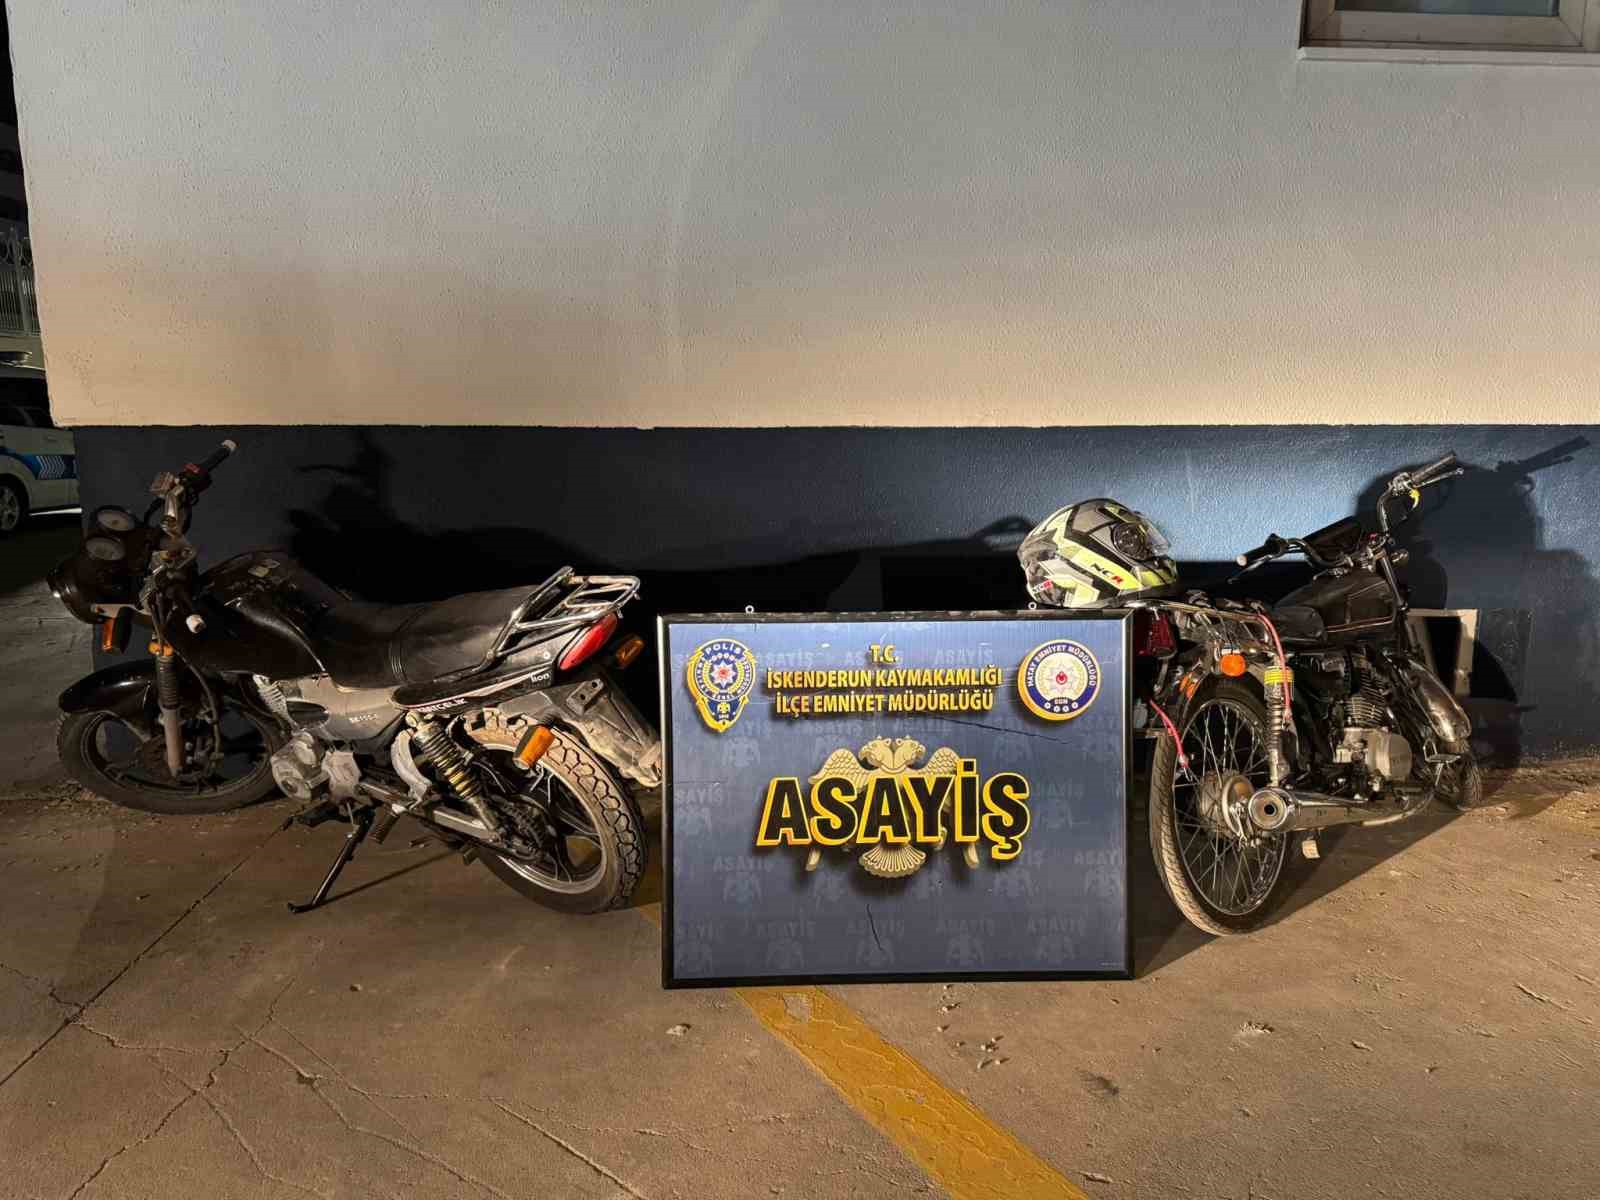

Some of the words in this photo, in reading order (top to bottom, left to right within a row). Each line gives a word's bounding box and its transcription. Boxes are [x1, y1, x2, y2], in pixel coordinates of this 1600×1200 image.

[1091, 562, 1124, 584] NCR
[704, 642, 742, 655] POLİS
[869, 645, 899, 663] T.C.
[767, 668, 873, 689] İSKENDERUN
[875, 664, 1004, 688] KAYMAKAMLIĞI
[776, 692, 811, 718] İLÇE
[813, 691, 885, 713] EMNİYET
[888, 688, 995, 713] MÜDÜRLÜĞÜ
[756, 758, 1031, 860] ASAYİŞ
